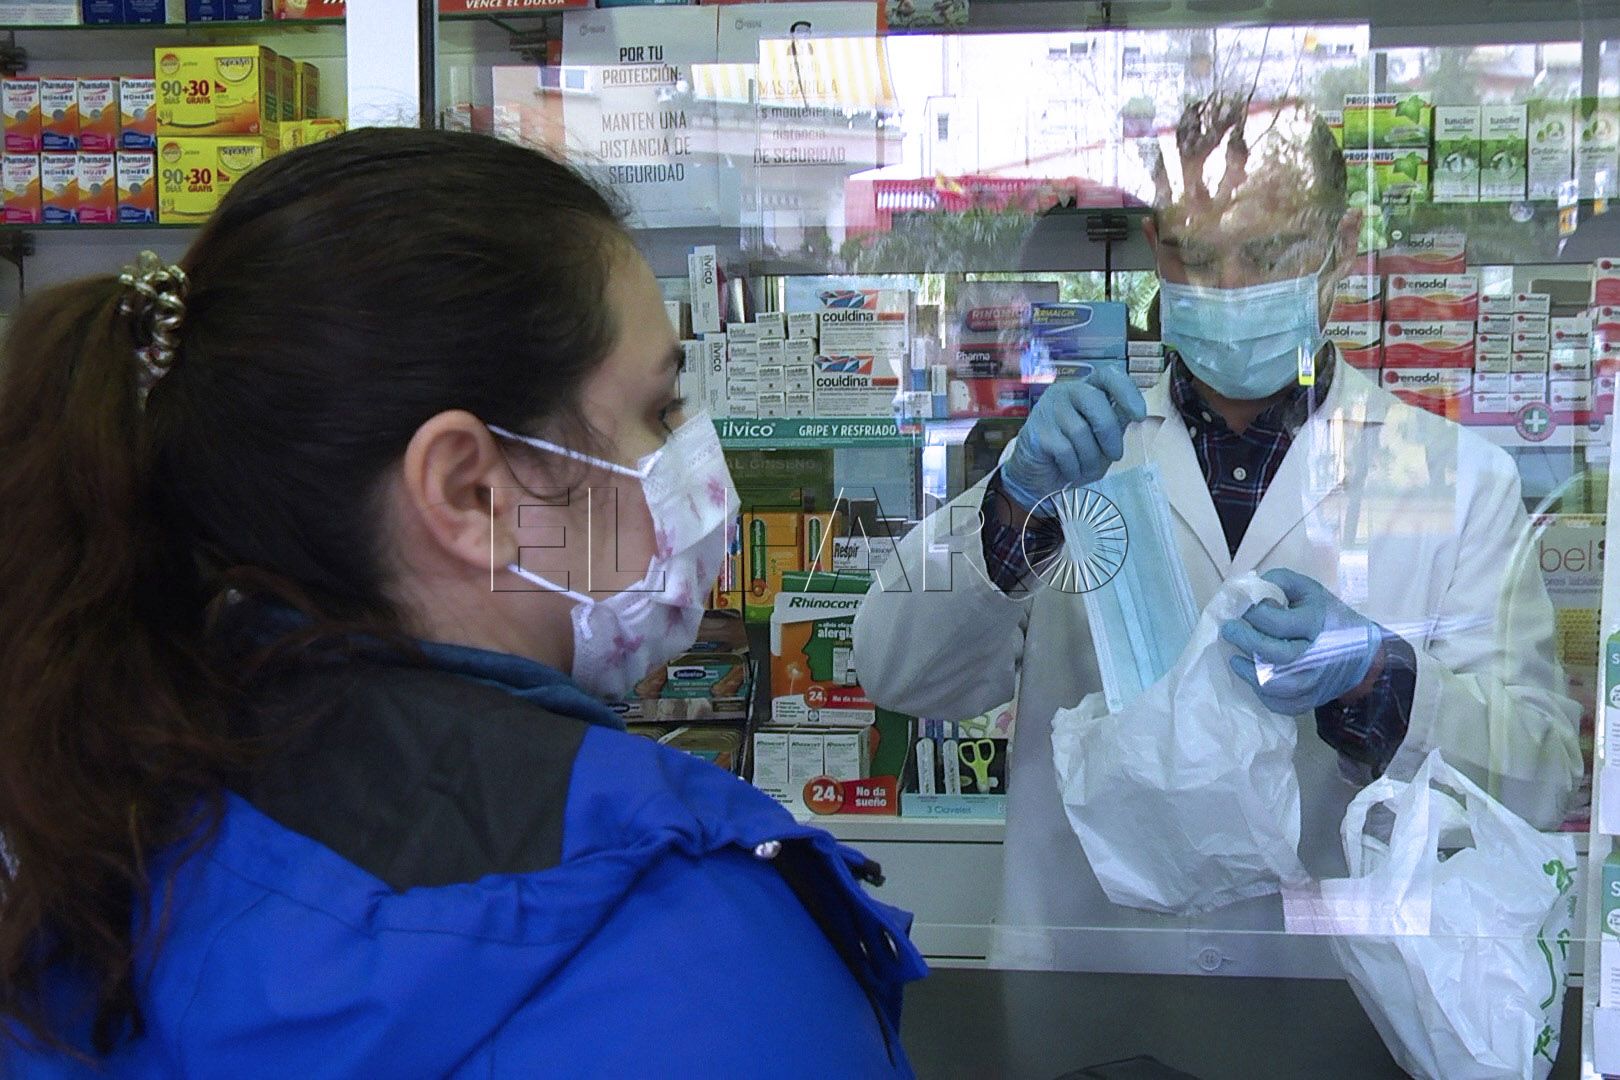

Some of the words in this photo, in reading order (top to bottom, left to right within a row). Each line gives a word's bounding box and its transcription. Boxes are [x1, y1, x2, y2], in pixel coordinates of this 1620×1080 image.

[619, 47, 644, 62] POR
[648, 46, 663, 61] TU
[602, 114, 655, 132] MANTEN
[659, 111, 687, 130] UNA
[600, 138, 670, 158] DISTANCIA
[675, 136, 692, 156] DE
[608, 163, 685, 184] SEGURIDAD
[822, 310, 874, 322] couldina
[816, 375, 868, 387] couldina
[722, 421, 774, 437] ilvico
[799, 425, 830, 437] GRIPE
[831, 425, 840, 437] Y
[841, 424, 896, 437] RESFRIADO
[788, 596, 859, 609] Rhinocort
[812, 785, 836, 802] 24
[856, 786, 870, 797] No
[873, 786, 886, 797] da
[855, 796, 887, 808] sueño
